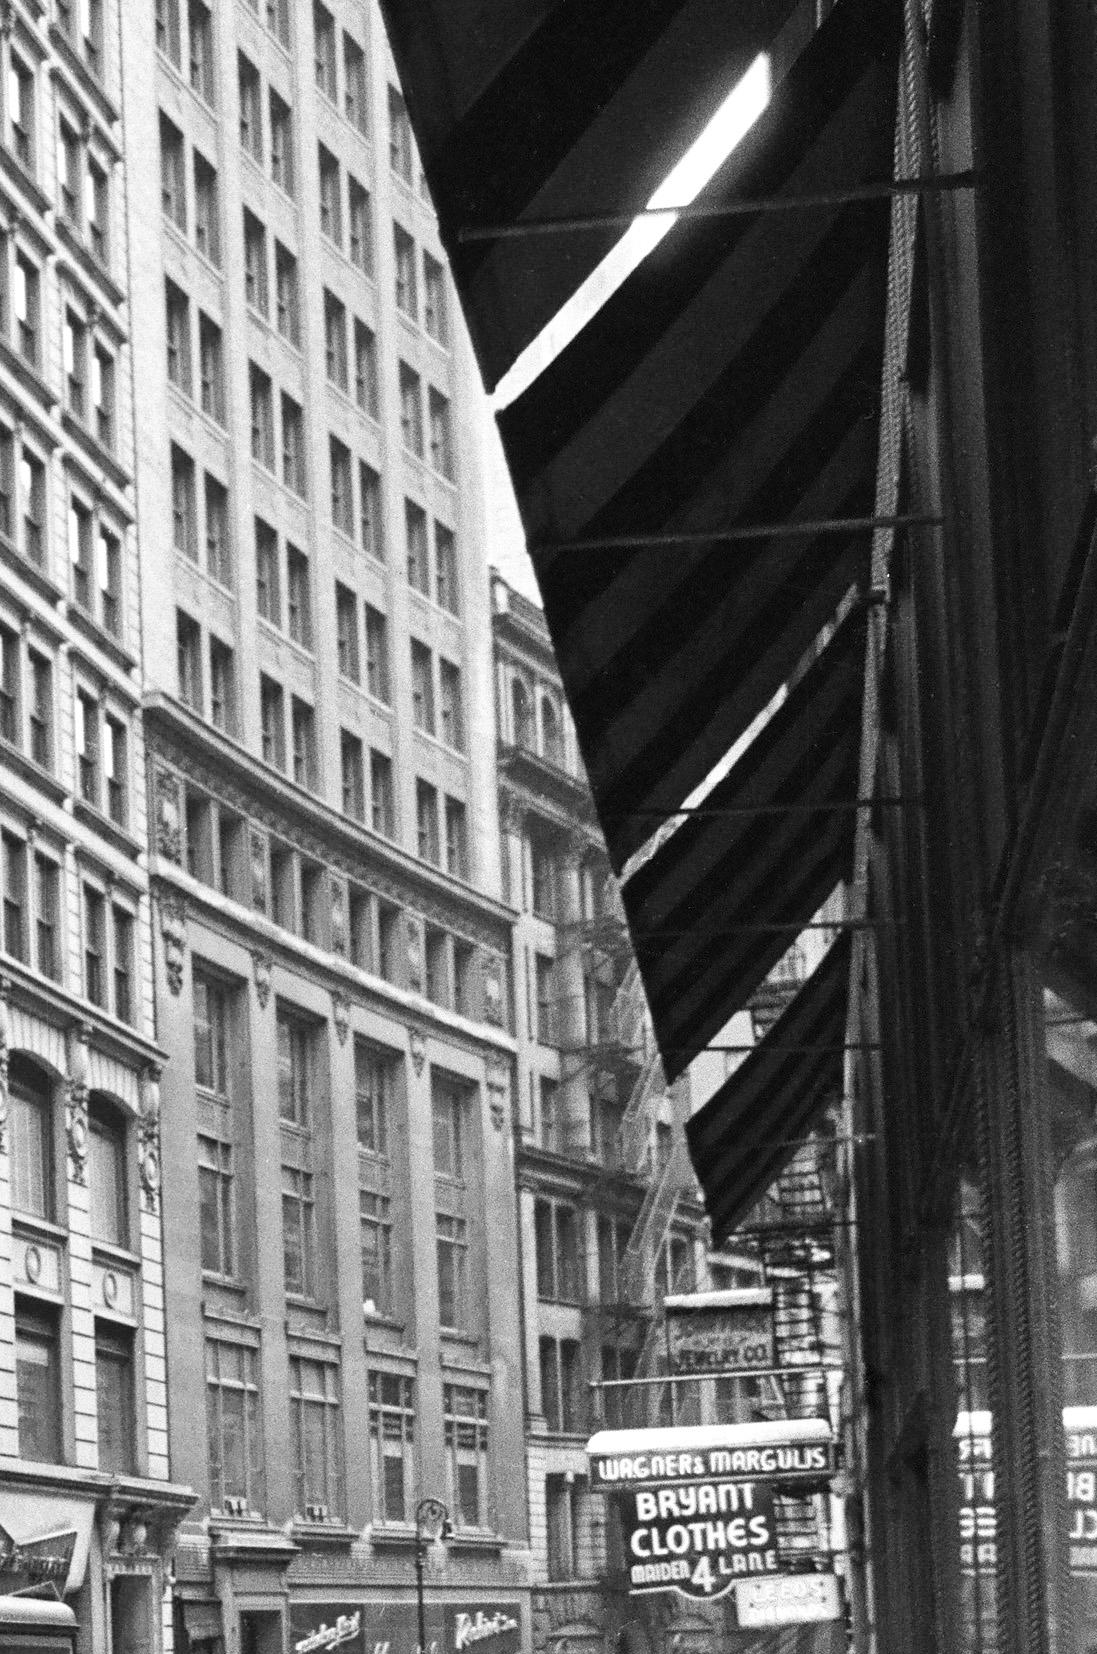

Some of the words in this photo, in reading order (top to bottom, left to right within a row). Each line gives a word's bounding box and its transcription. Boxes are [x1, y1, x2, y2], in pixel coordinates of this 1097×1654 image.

[710, 1447, 826, 1473] MARGULIS
[636, 1483, 755, 1521] BRYANT
[631, 1515, 769, 1557] CLOTHES
[631, 1560, 691, 1584] MAIDEN
[691, 1556, 717, 1592] 4
[719, 1550, 777, 1575] LANE
